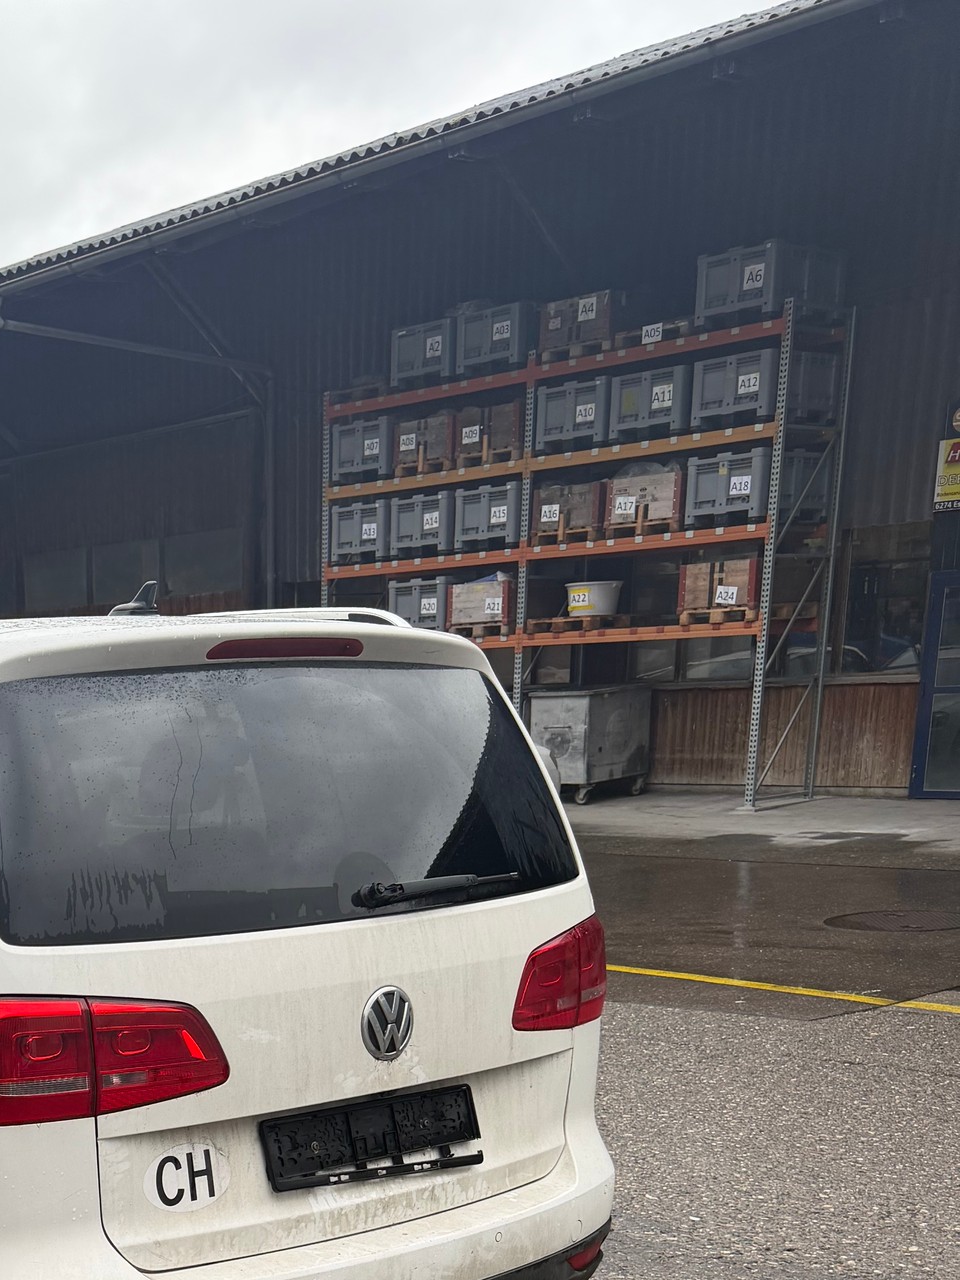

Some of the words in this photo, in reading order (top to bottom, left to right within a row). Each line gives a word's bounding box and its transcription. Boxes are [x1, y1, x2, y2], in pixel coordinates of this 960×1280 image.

[746, 269, 762, 284] A6
[580, 303, 594, 315] A4
[494, 324, 510, 335] A03
[644, 326, 661, 339] A05
[740, 376, 758, 389] A12
[653, 389, 672, 403] A11
[577, 407, 594, 418] A10
[464, 428, 478, 441] A09
[365, 441, 379, 451] A07
[731, 478, 749, 492] A18
[616, 501, 634, 512] A17
[491, 508, 506, 520] A15
[542, 508, 558, 520] A16
[424, 515, 438, 527] A14
[363, 526, 376, 537] A13
[571, 593, 587, 604] A22
[717, 590, 735, 602] A24
[422, 600, 436, 612] A20
[486, 600, 501, 611] A21
[155, 1149, 216, 1206] CH
